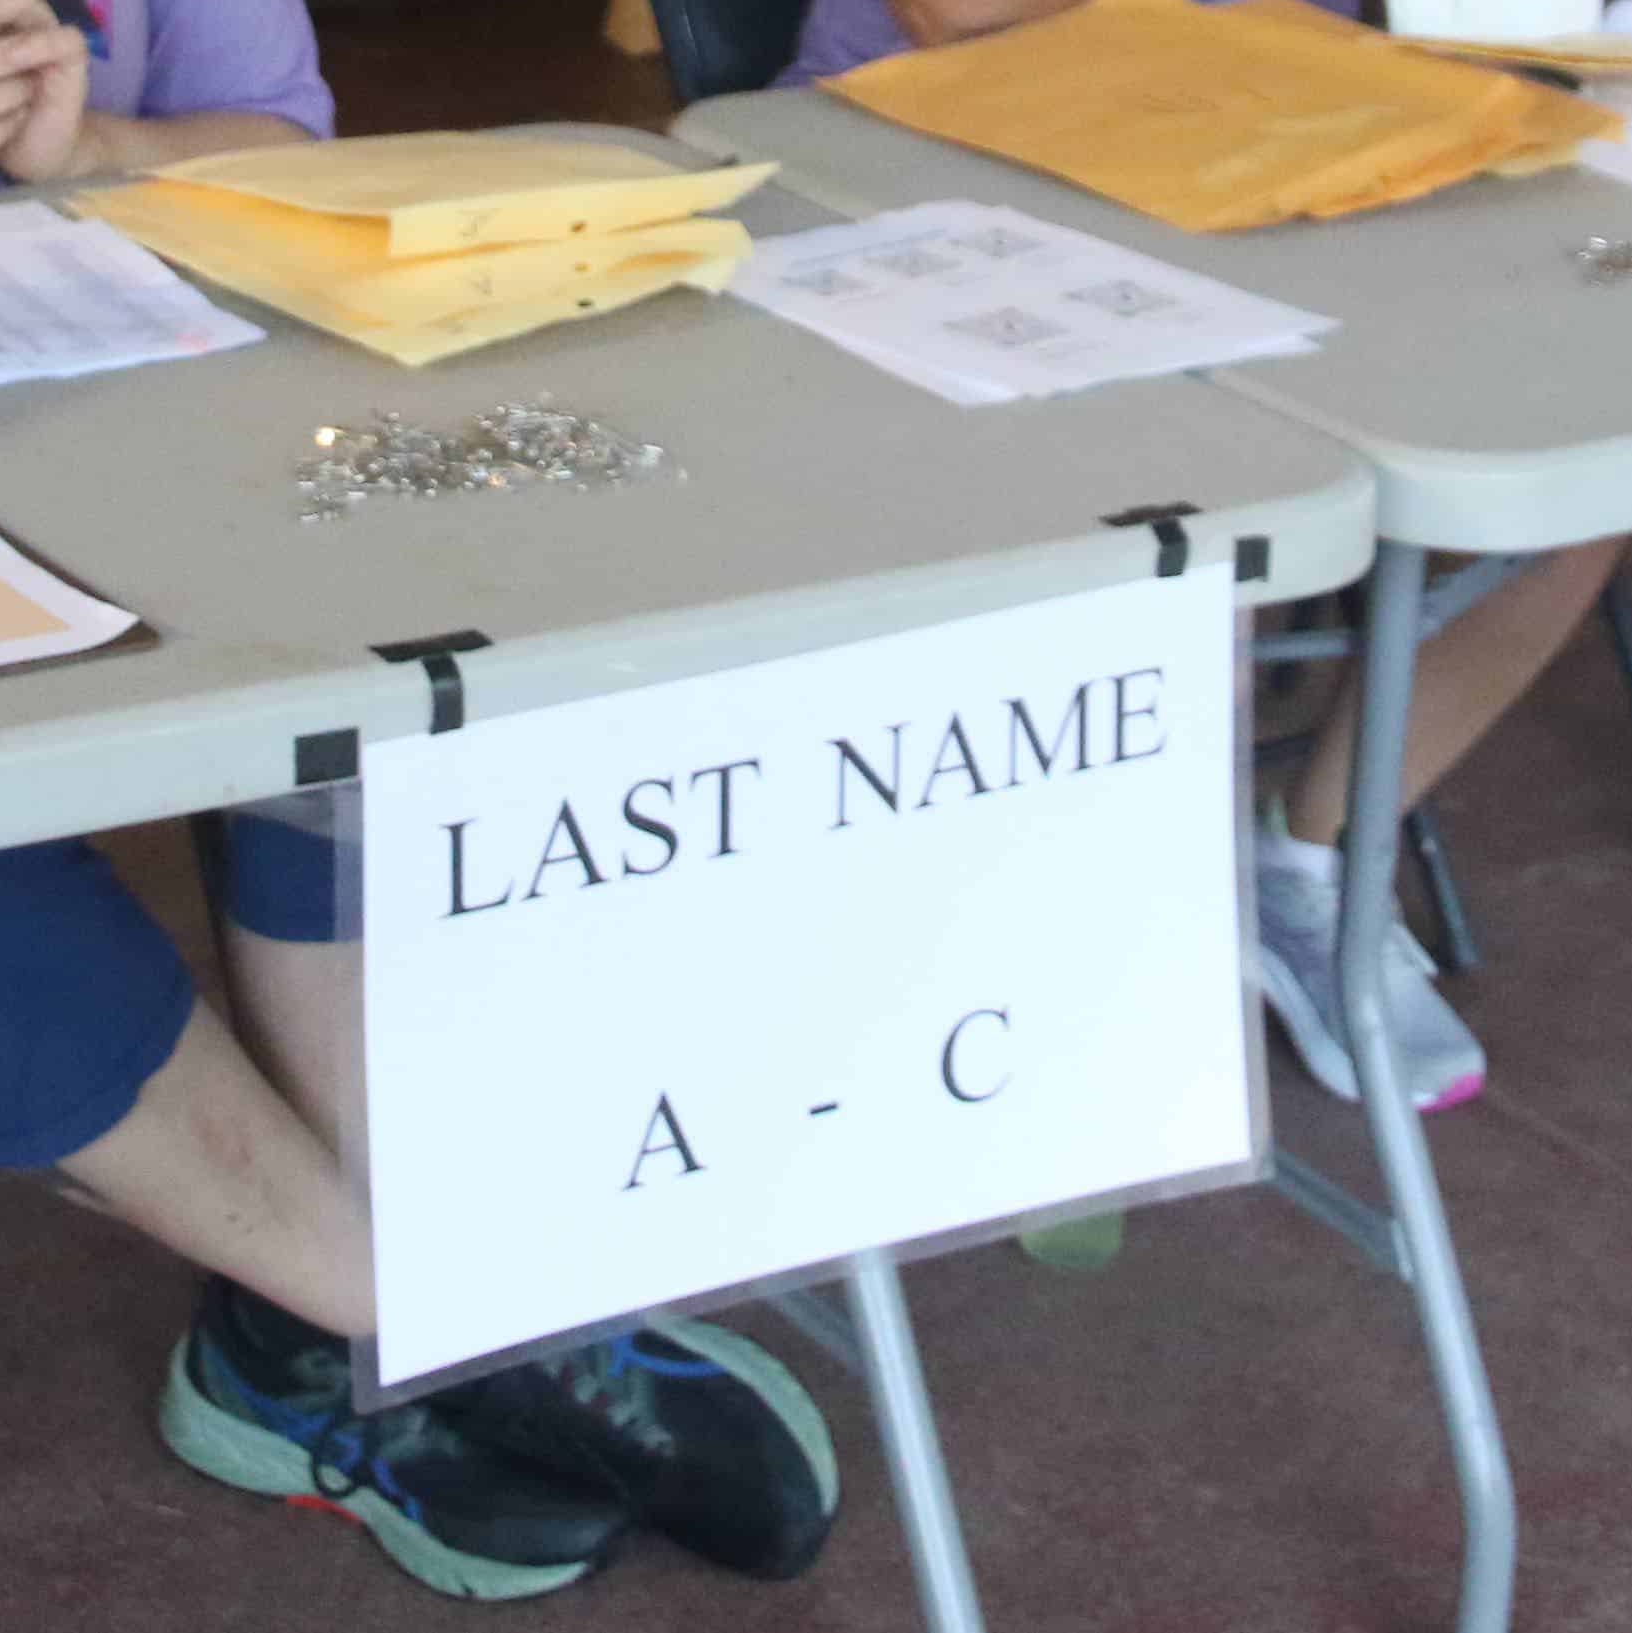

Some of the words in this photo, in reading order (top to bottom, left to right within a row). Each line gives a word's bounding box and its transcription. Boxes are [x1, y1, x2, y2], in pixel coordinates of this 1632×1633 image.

[440, 758, 763, 919] LAST
[825, 667, 1166, 832] NAME
[621, 1090, 708, 1191] A
[809, 1102, 839, 1115] -
[940, 1005, 1013, 1103] C
